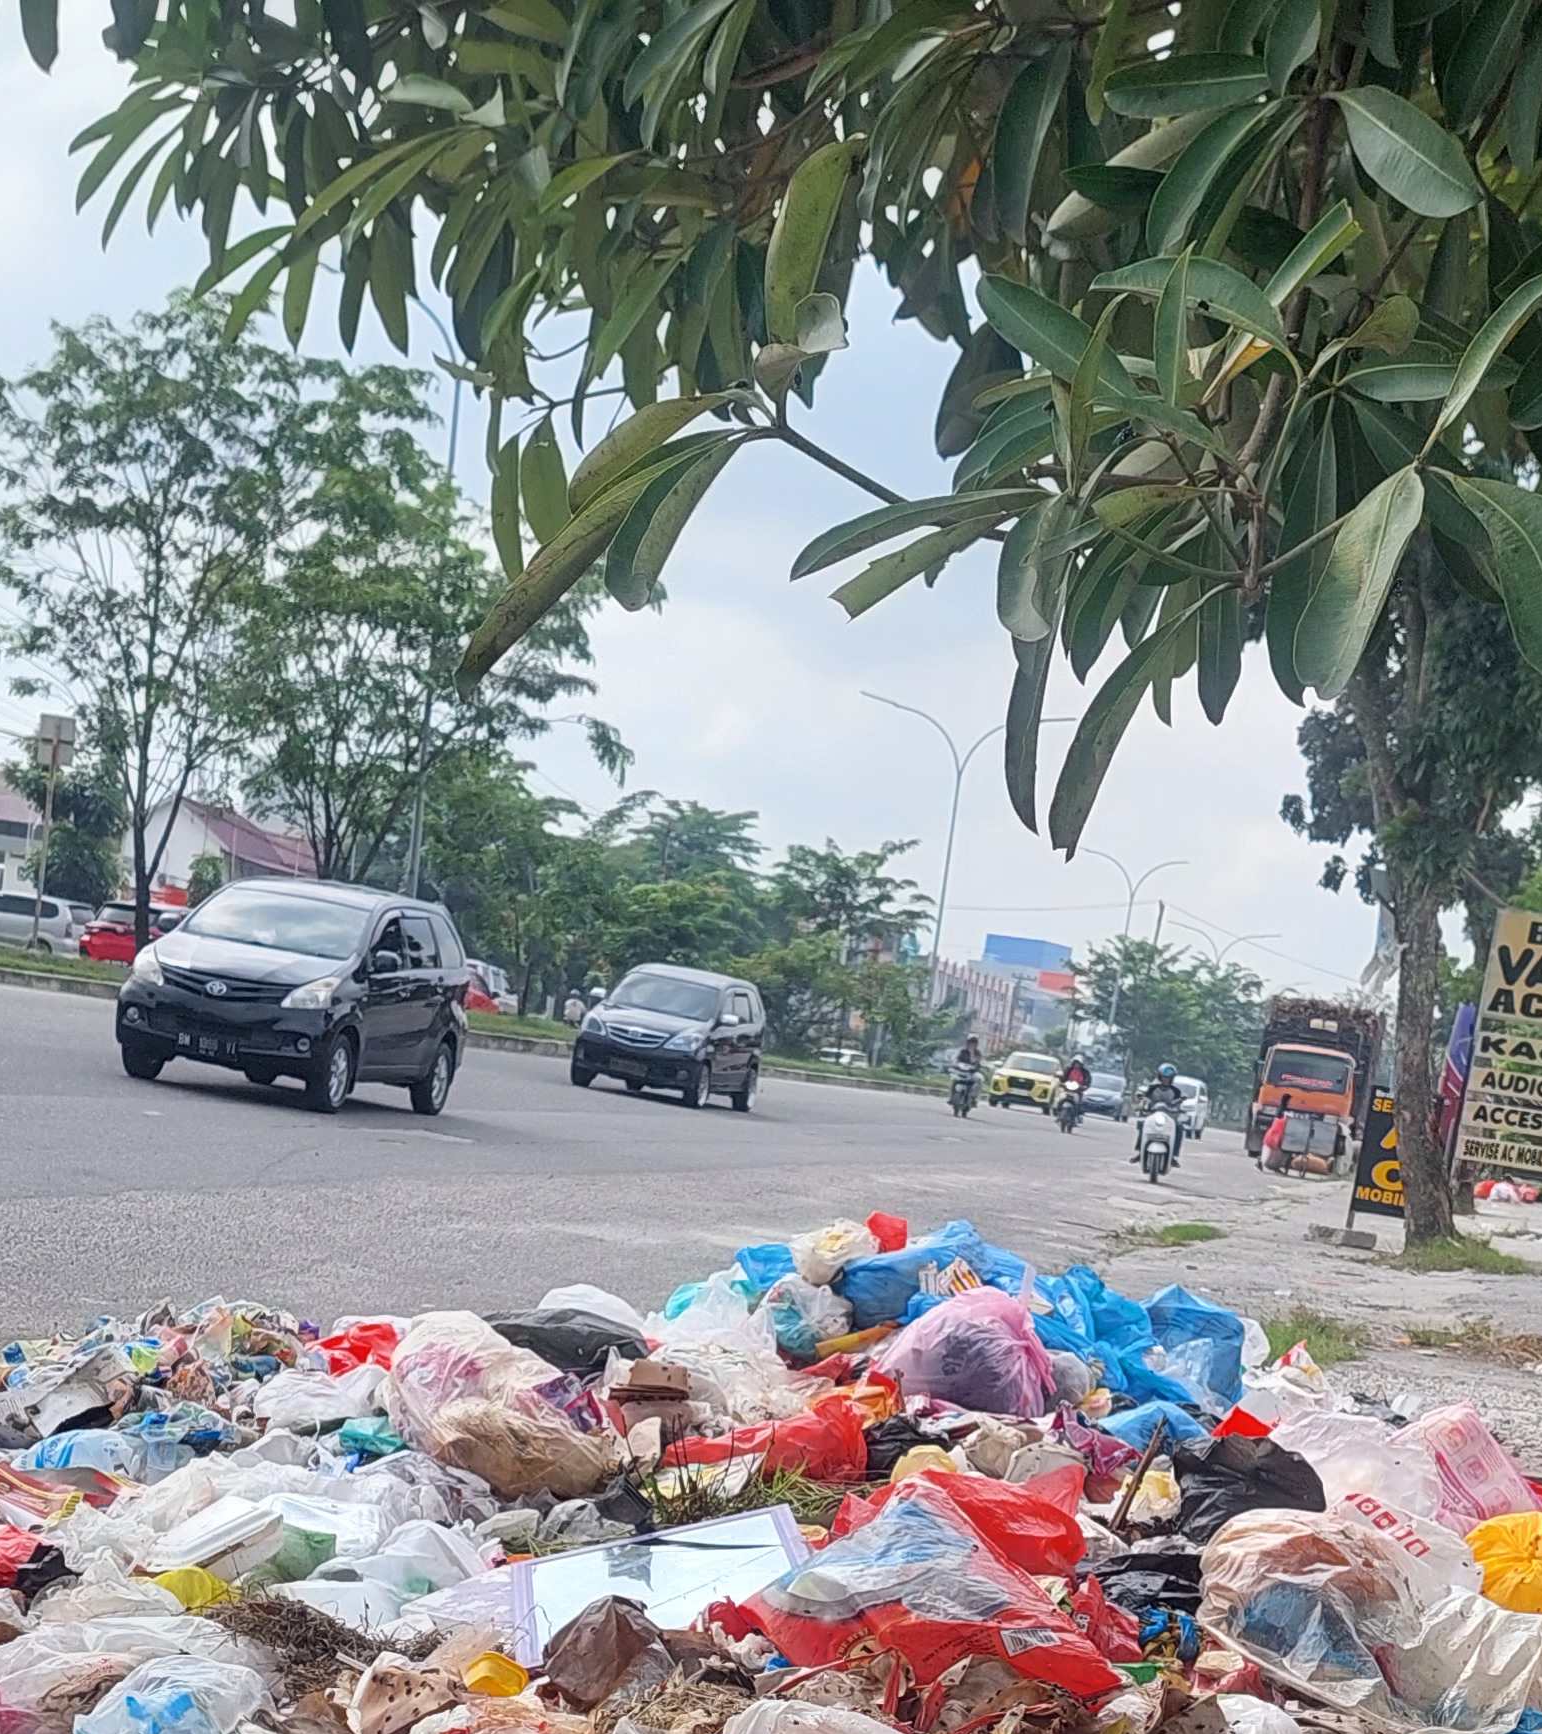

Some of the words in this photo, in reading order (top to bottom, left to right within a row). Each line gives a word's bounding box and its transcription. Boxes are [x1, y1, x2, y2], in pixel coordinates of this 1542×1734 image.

[1463, 1139, 1500, 1160] SERVISE
[1501, 1145, 1514, 1161] AC
[1515, 1147, 1542, 1167] MOBIL
